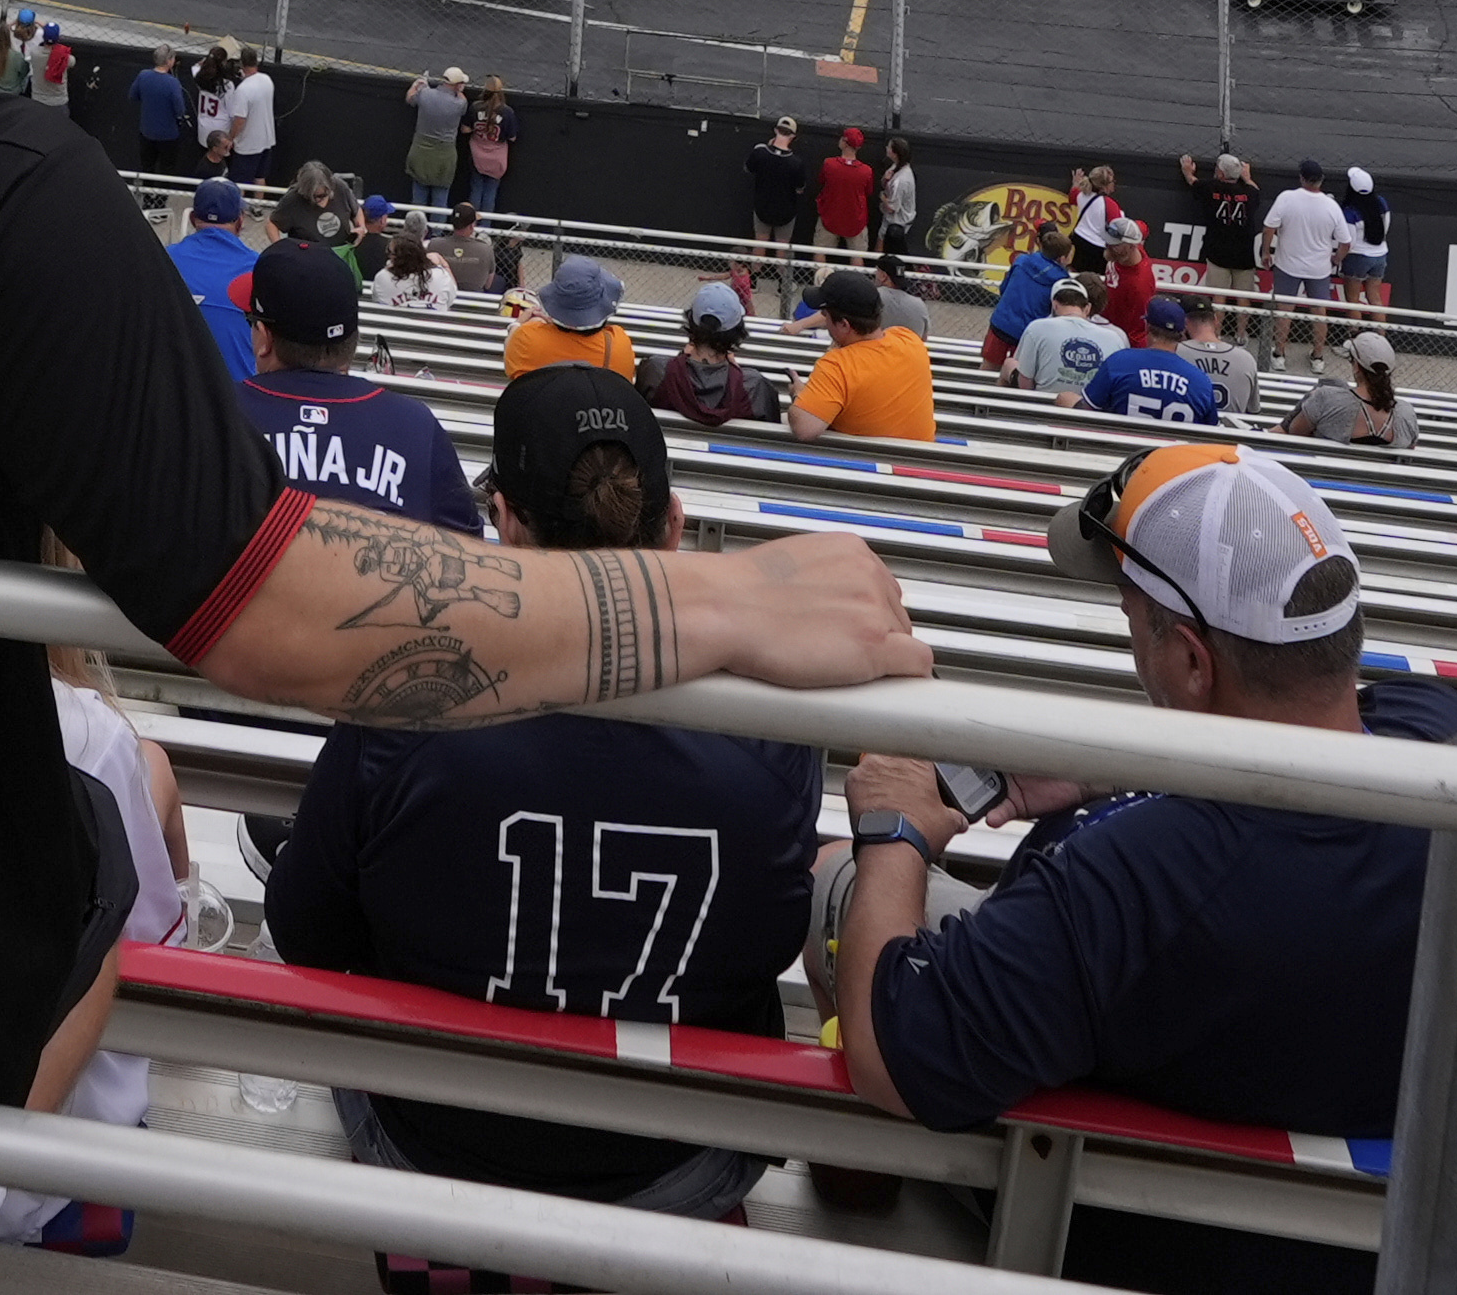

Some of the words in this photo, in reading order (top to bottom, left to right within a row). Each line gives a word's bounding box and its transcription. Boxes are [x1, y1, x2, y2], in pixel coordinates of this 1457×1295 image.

[200, 94, 219, 117] 13
[1006, 188, 1072, 229] Bass
[1216, 201, 1247, 226] 44
[1194, 356, 1231, 376] DIAZ
[1138, 368, 1189, 396] BETTS
[576, 408, 629, 433] 2024
[355, 444, 406, 507] JR.
[1298, 516, 1322, 552] VOLS
[486, 810, 720, 1024] 17
